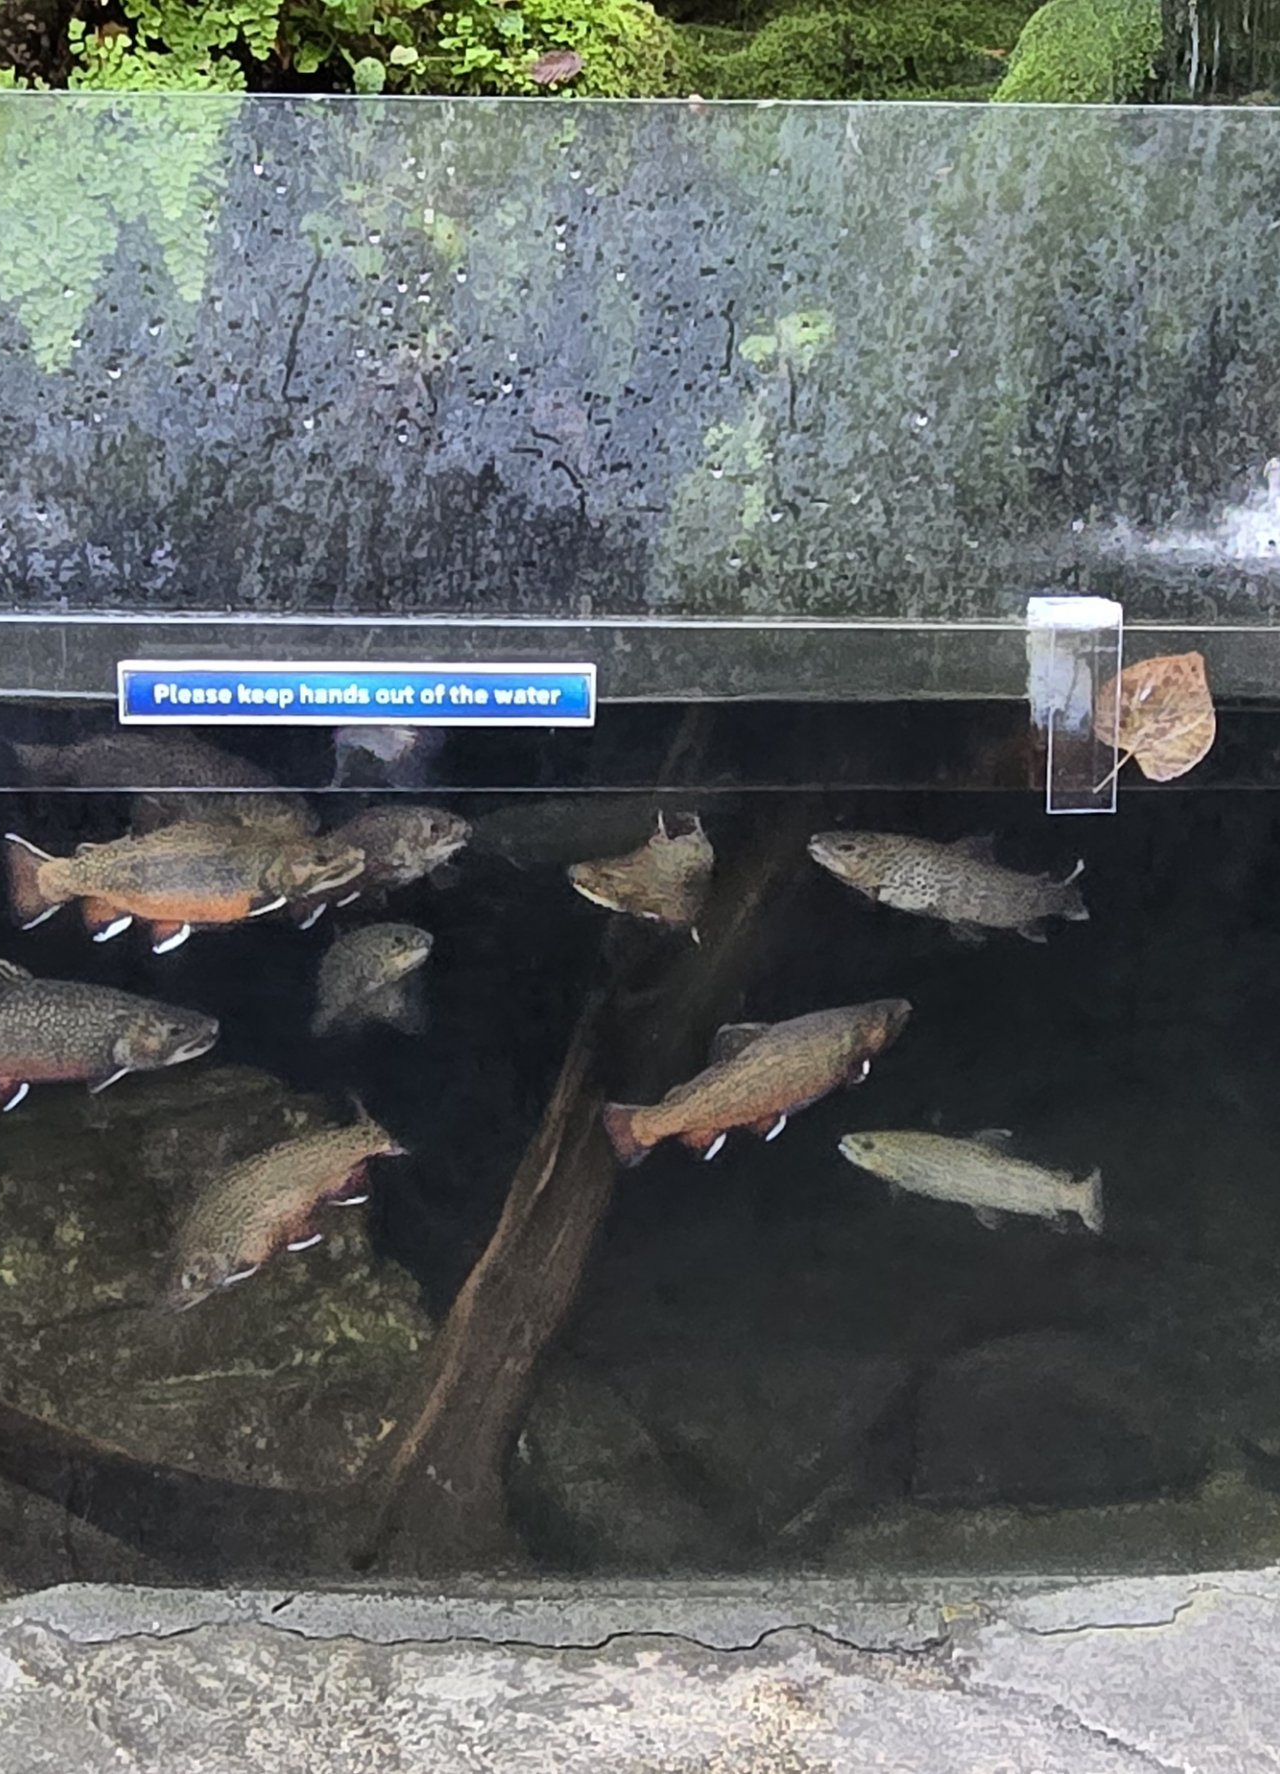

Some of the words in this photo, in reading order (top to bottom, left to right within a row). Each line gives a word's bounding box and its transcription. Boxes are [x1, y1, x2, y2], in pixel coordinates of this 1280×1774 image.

[153, 682, 232, 705] Please
[237, 683, 294, 709] keep
[299, 683, 370, 705] hands
[375, 685, 415, 705] out
[419, 683, 445, 705] of
[449, 683, 488, 705] the
[493, 686, 561, 706] water
